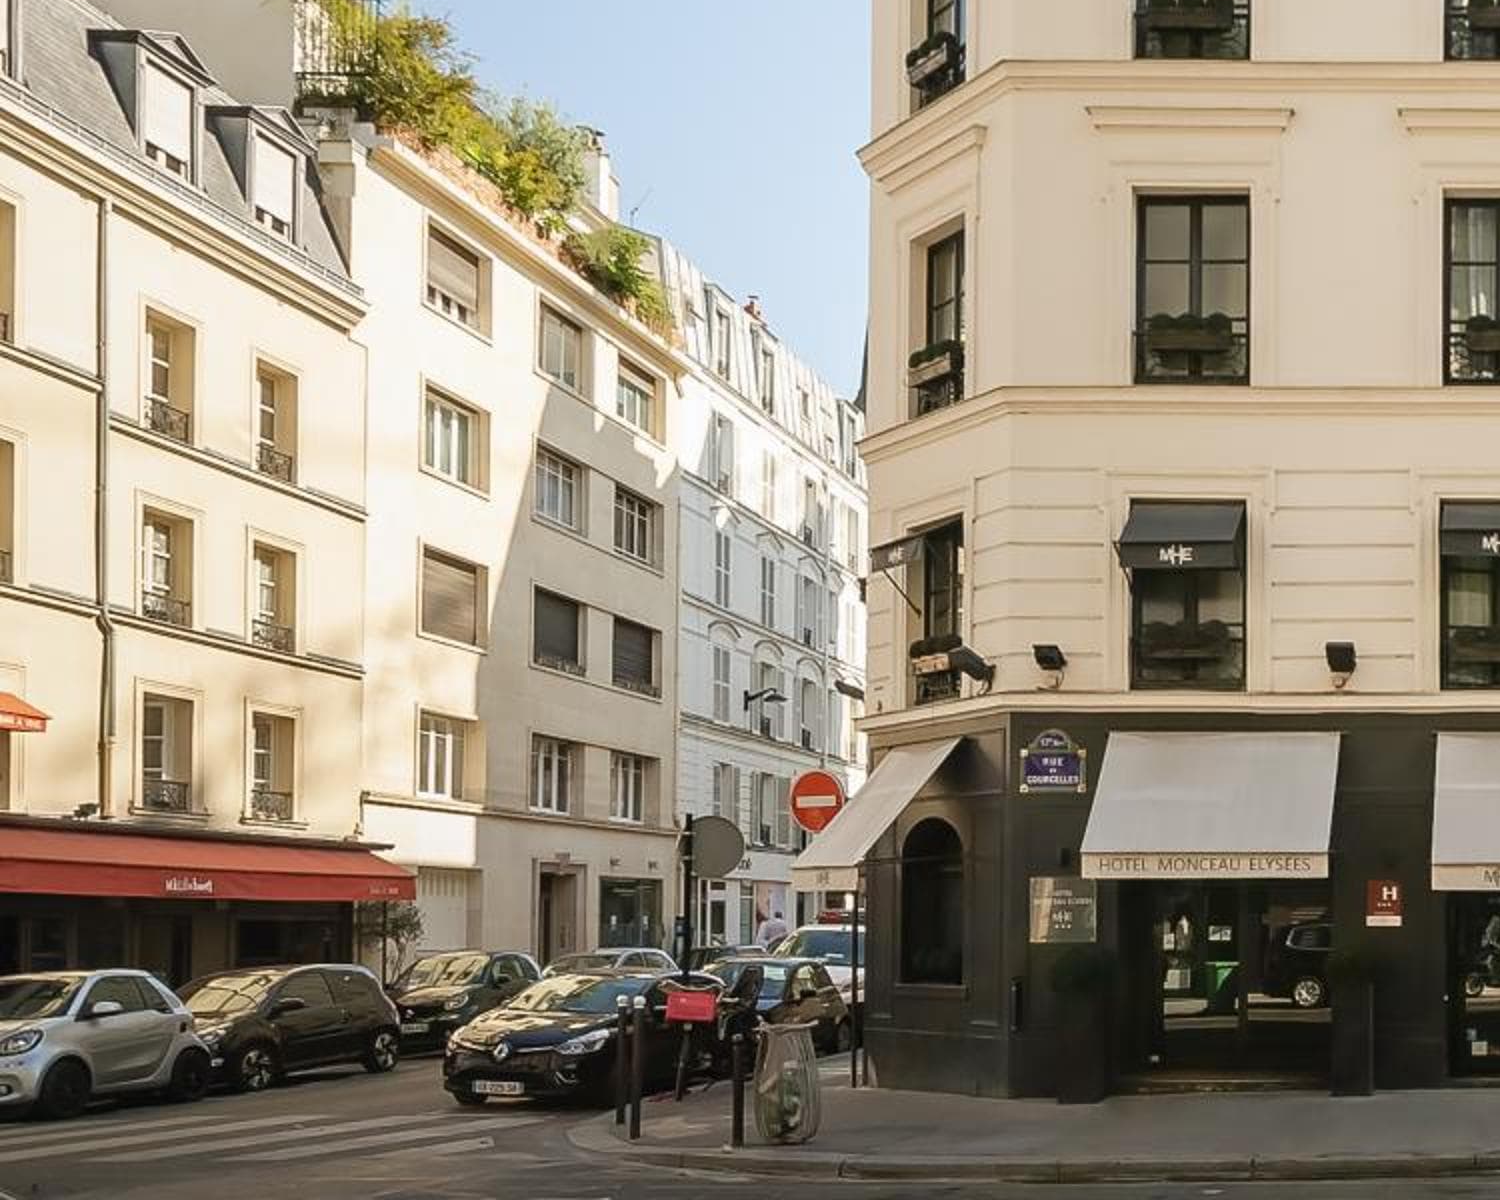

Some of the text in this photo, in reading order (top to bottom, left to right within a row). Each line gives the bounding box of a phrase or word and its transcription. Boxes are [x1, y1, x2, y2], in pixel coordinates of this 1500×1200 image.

[1159, 543, 1193, 565] MHE
[1042, 757, 1065, 767] RUE
[1099, 857, 1148, 871] HOTEL
[1157, 857, 1242, 872] MONCEAU
[1382, 886, 1398, 900] H
